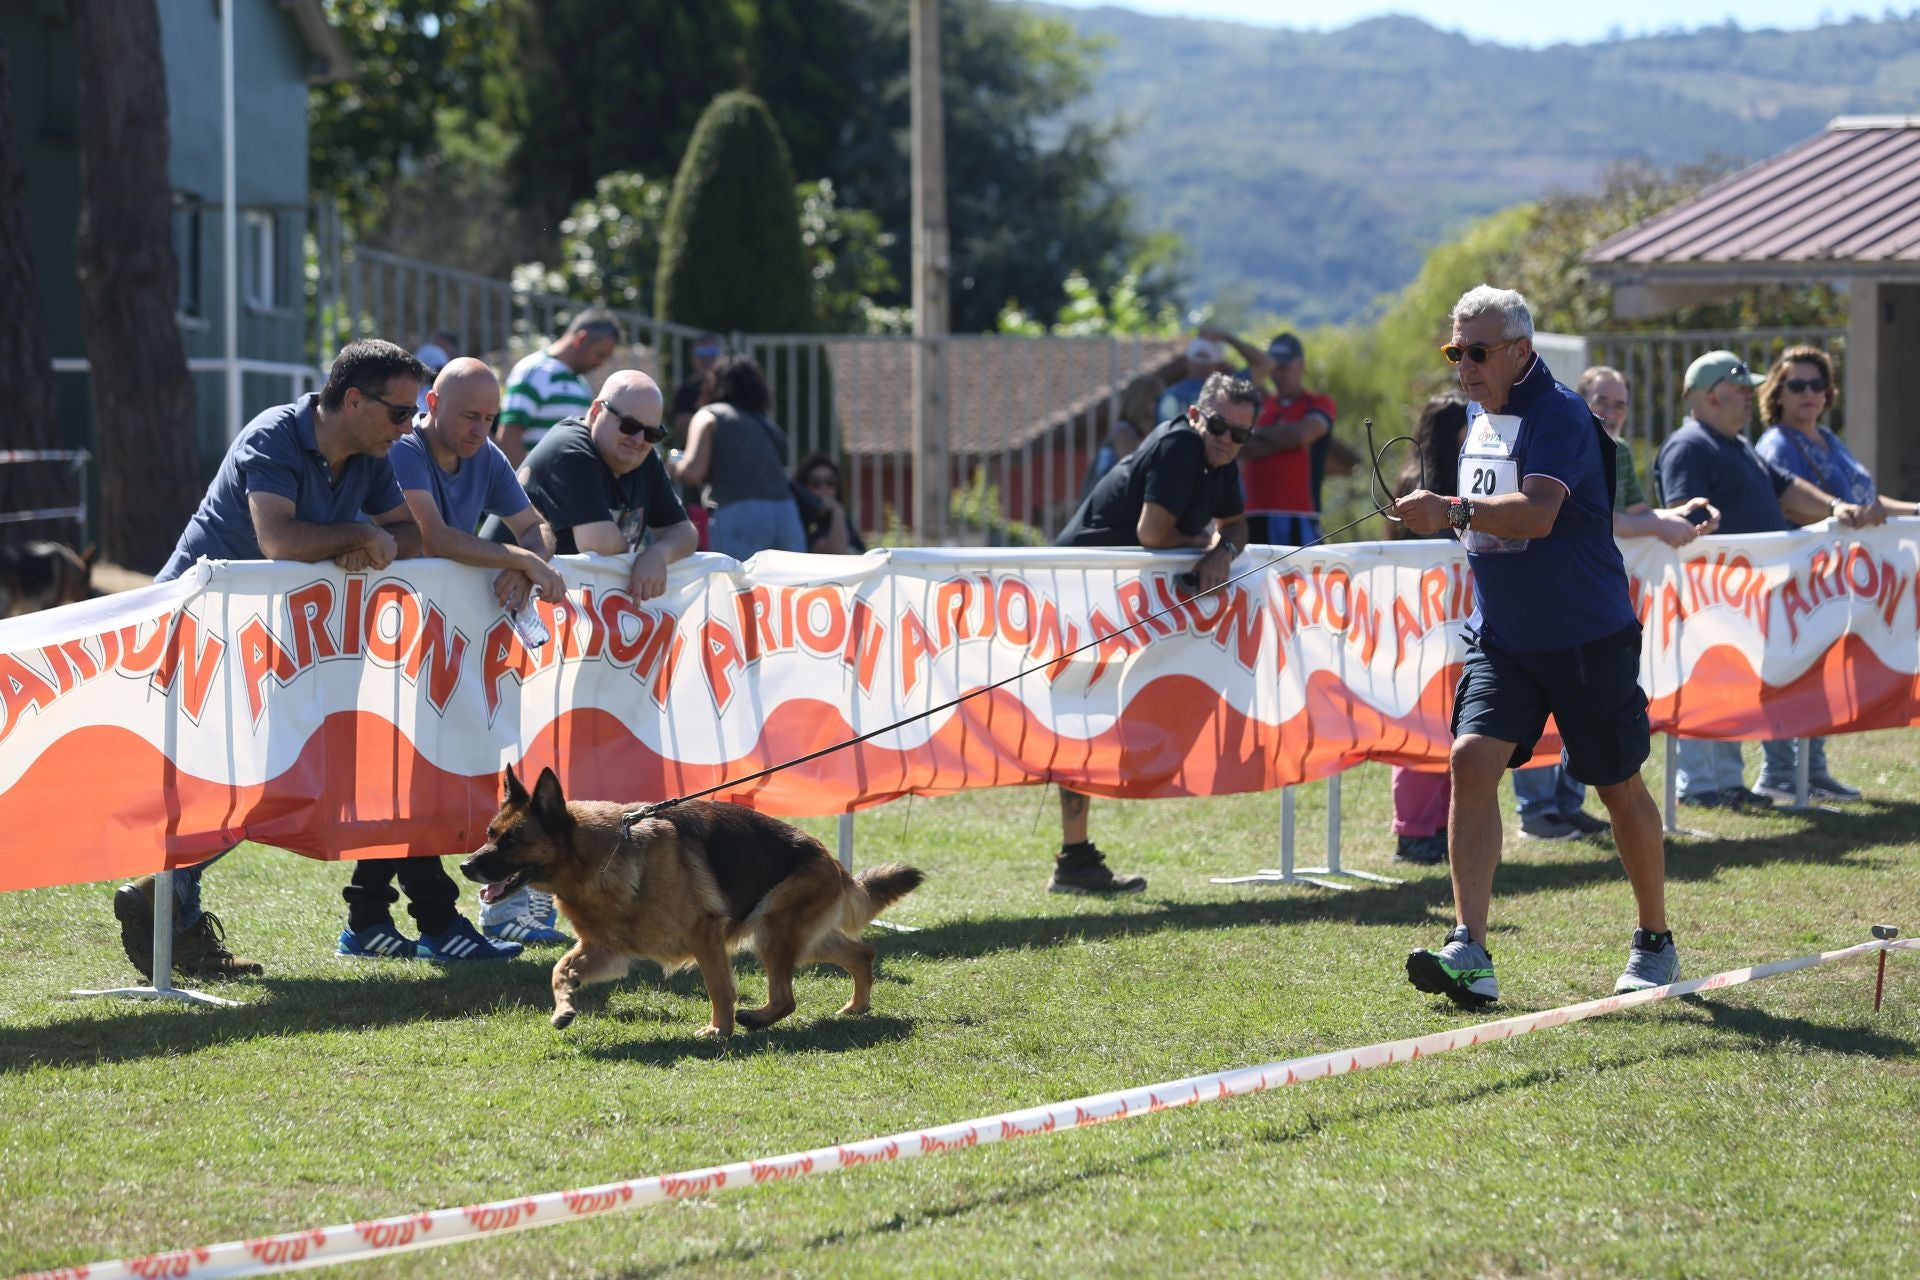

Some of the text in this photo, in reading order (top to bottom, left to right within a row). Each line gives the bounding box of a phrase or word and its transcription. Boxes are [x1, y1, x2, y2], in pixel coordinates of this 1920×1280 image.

[1471, 468, 1497, 495] 20
[237, 573, 470, 735] ARION
[481, 583, 687, 730] ARION
[698, 583, 886, 719] ARION
[898, 571, 1081, 706] ARION
[1084, 571, 1265, 698] ARION
[1660, 546, 1772, 657] ARION
[1780, 541, 1908, 650] ARION
